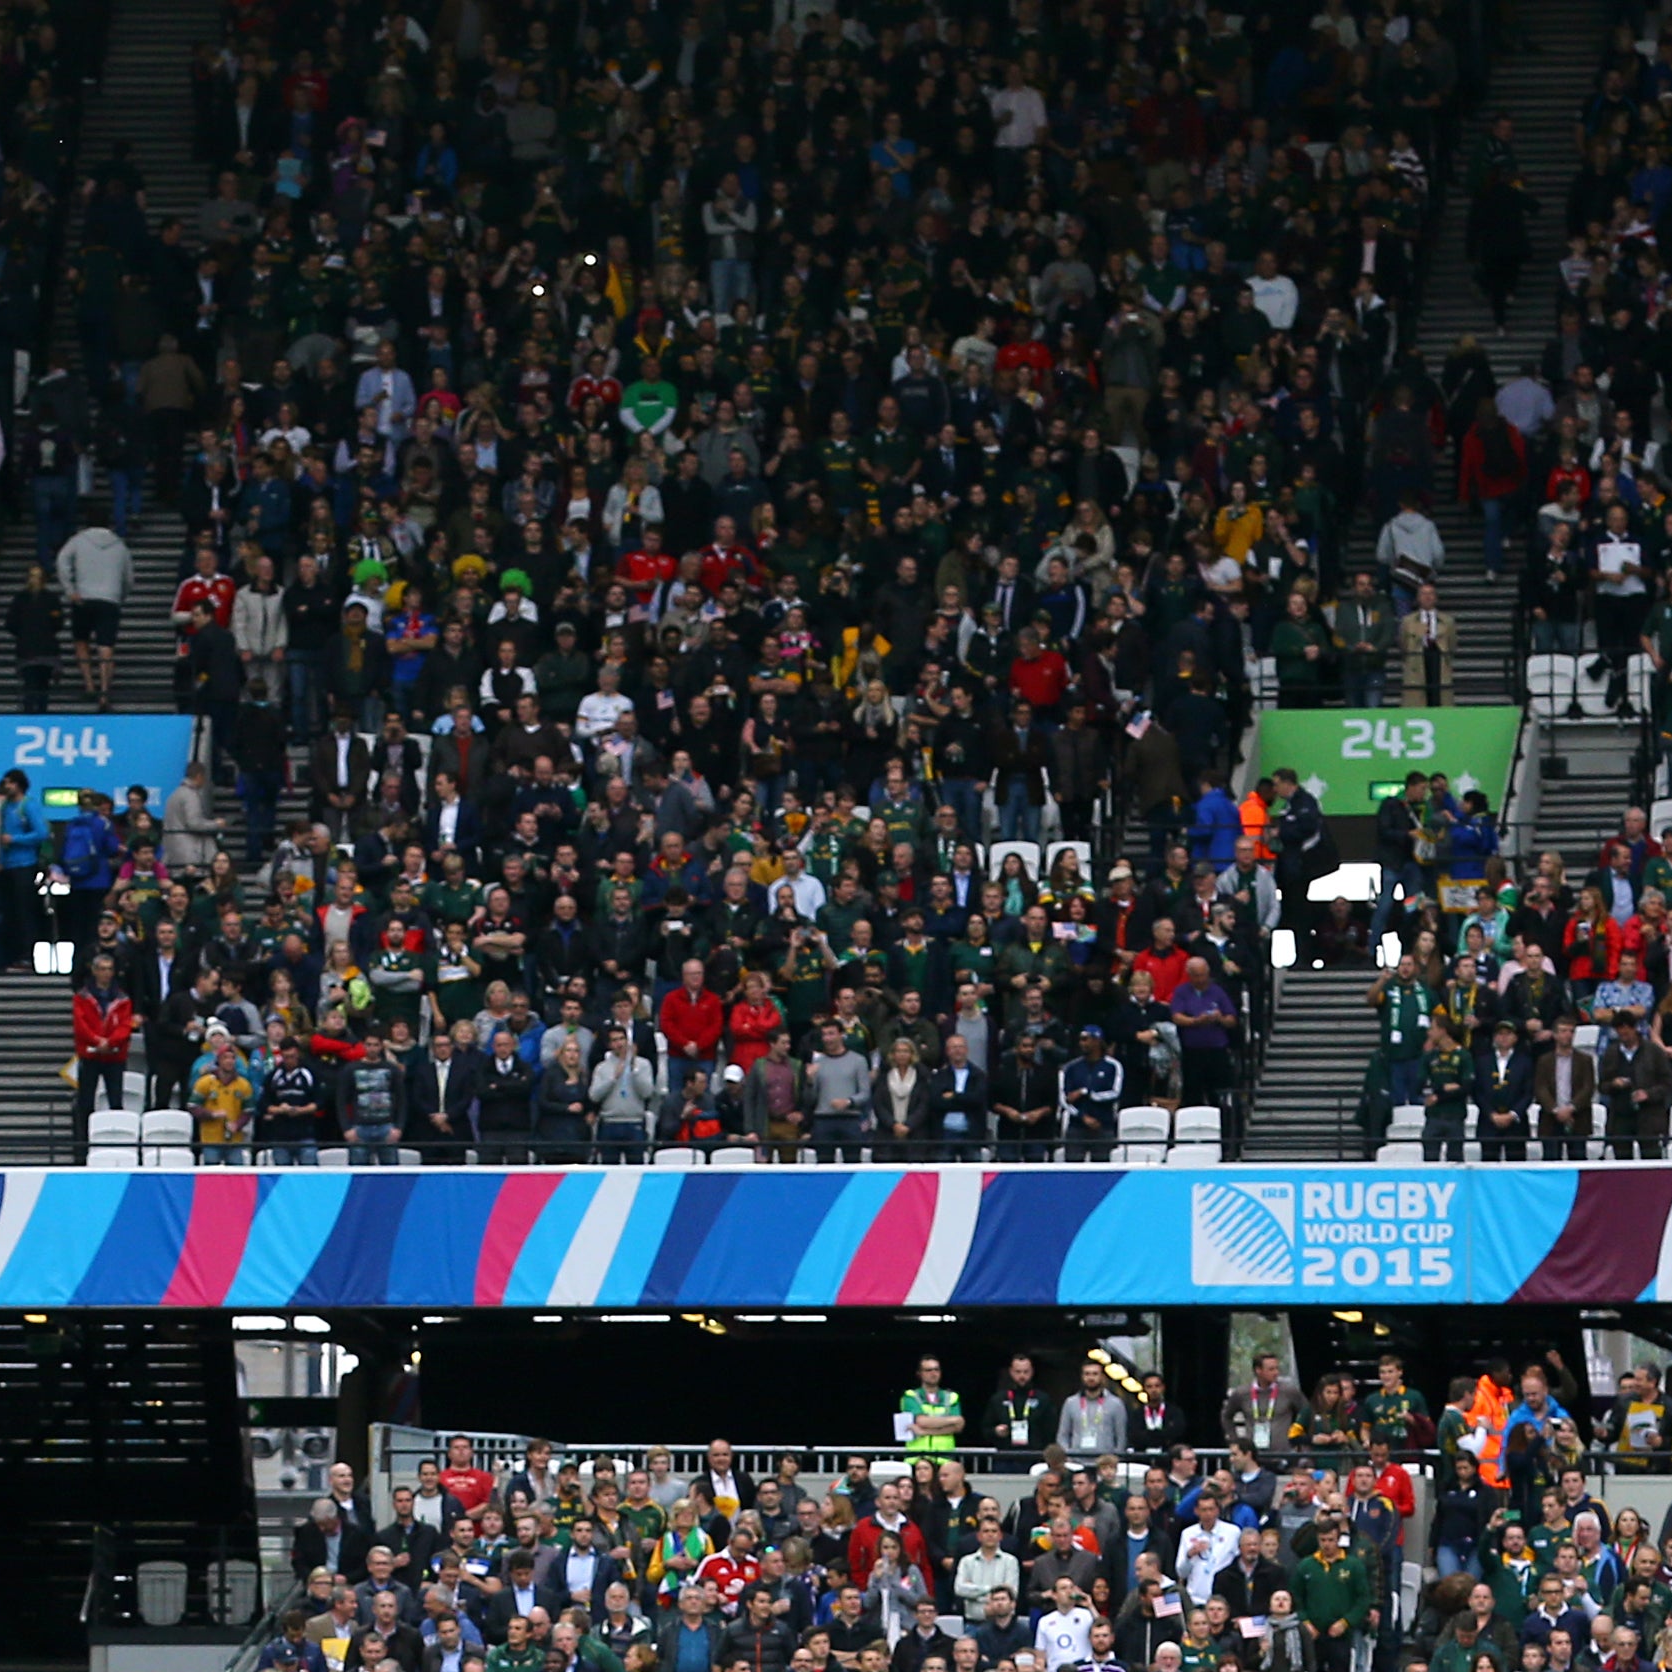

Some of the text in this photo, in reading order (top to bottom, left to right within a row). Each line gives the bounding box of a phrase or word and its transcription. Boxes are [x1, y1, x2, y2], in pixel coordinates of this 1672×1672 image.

[14, 726, 113, 767] 244
[1341, 719, 1436, 760] 243
[1302, 1181, 1457, 1219] RUGBY
[1303, 1222, 1455, 1244] WORLD CUP
[1301, 1246, 1454, 1286] 2015
